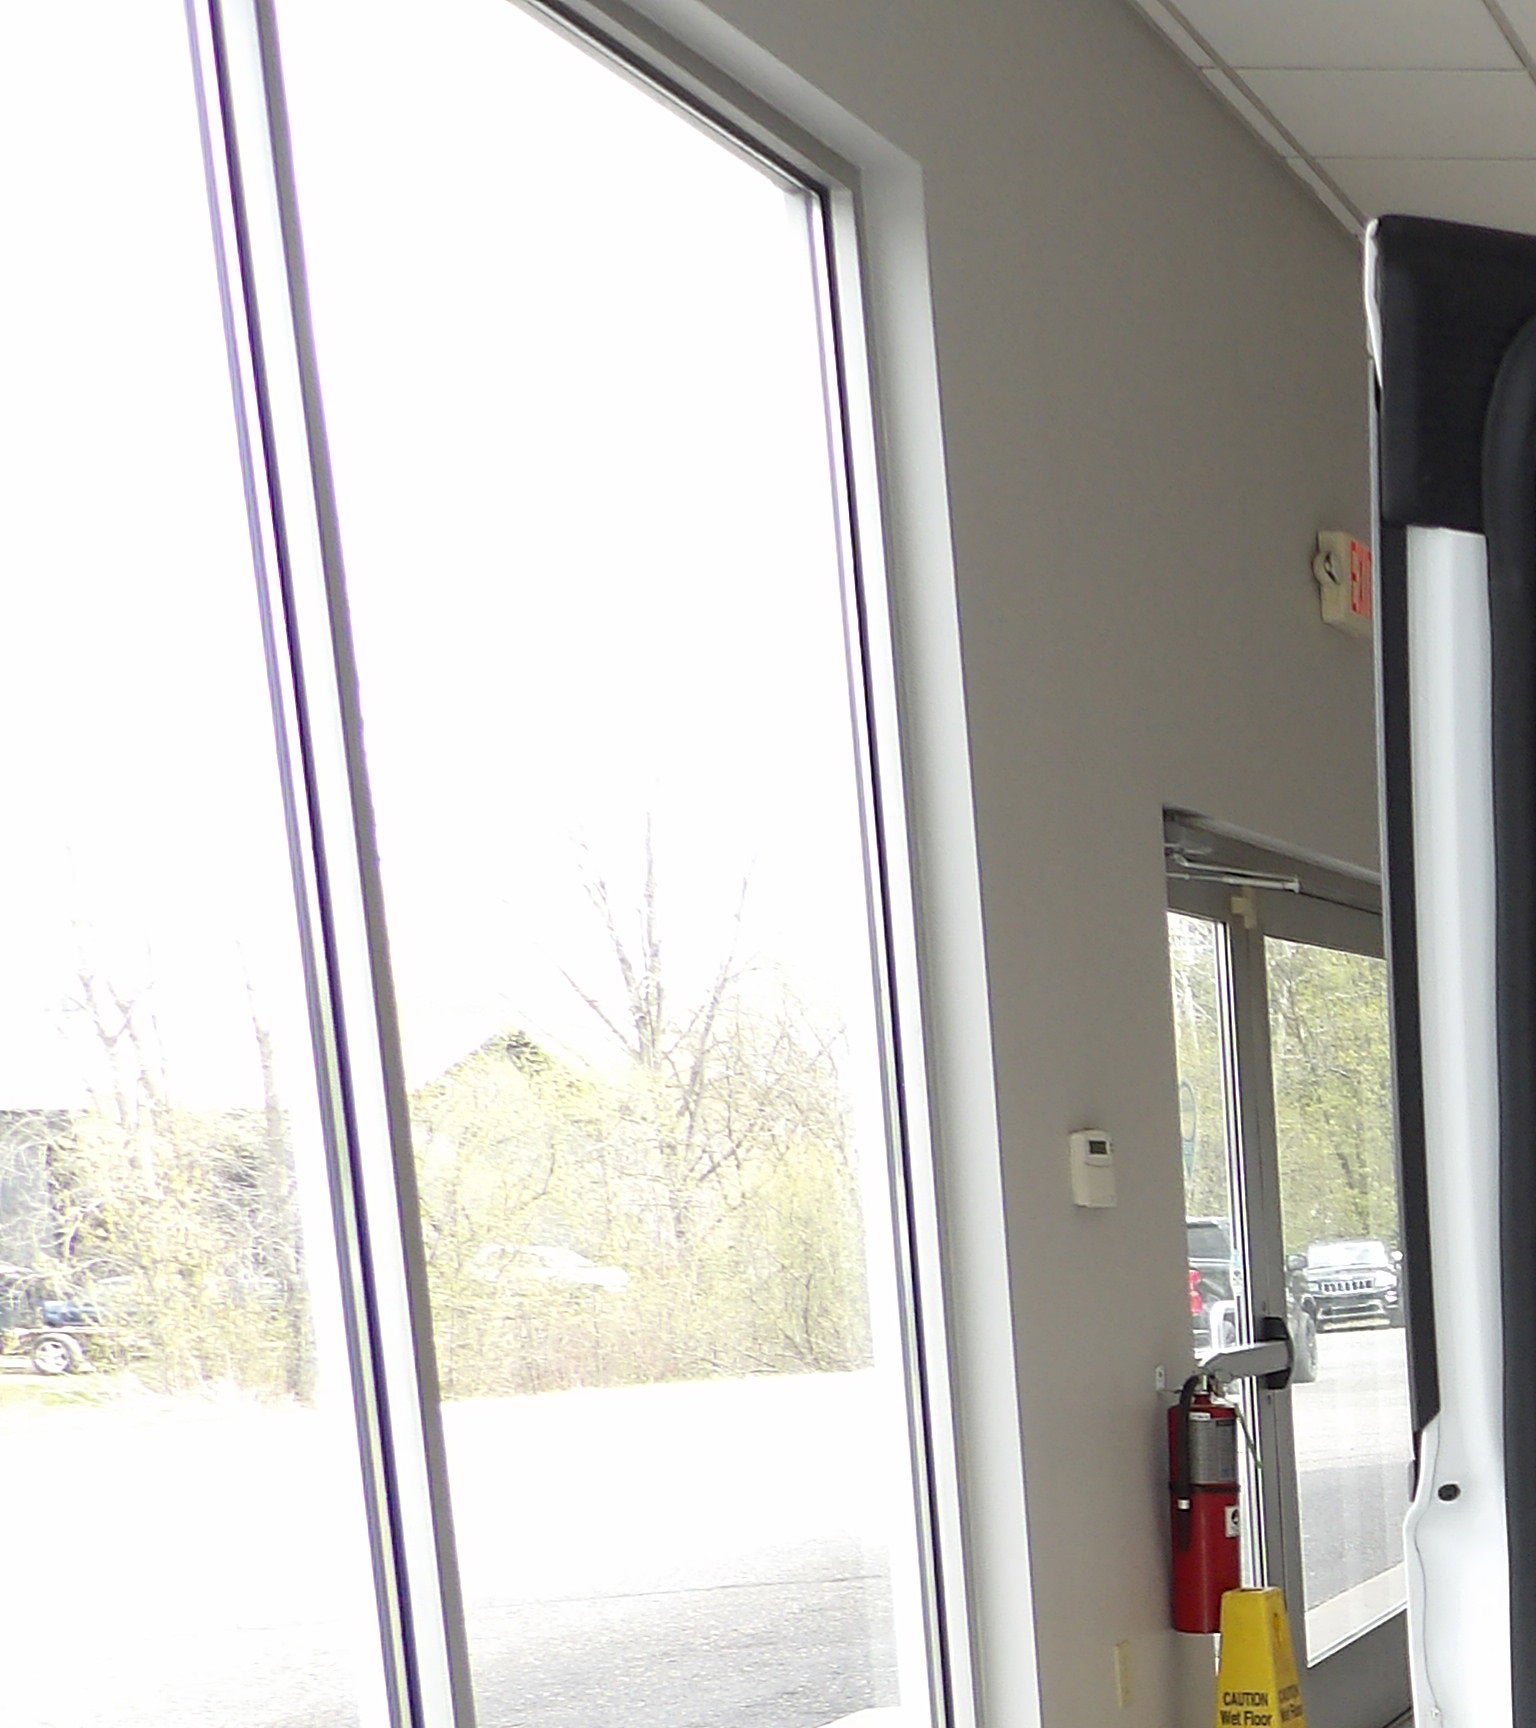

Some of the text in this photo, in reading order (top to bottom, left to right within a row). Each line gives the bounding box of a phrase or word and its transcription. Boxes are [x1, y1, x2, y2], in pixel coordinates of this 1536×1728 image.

[1222, 1692, 1268, 1707] CAUTION
[1220, 1710, 1242, 1726] Wet
[1244, 1710, 1272, 1727] Floor
